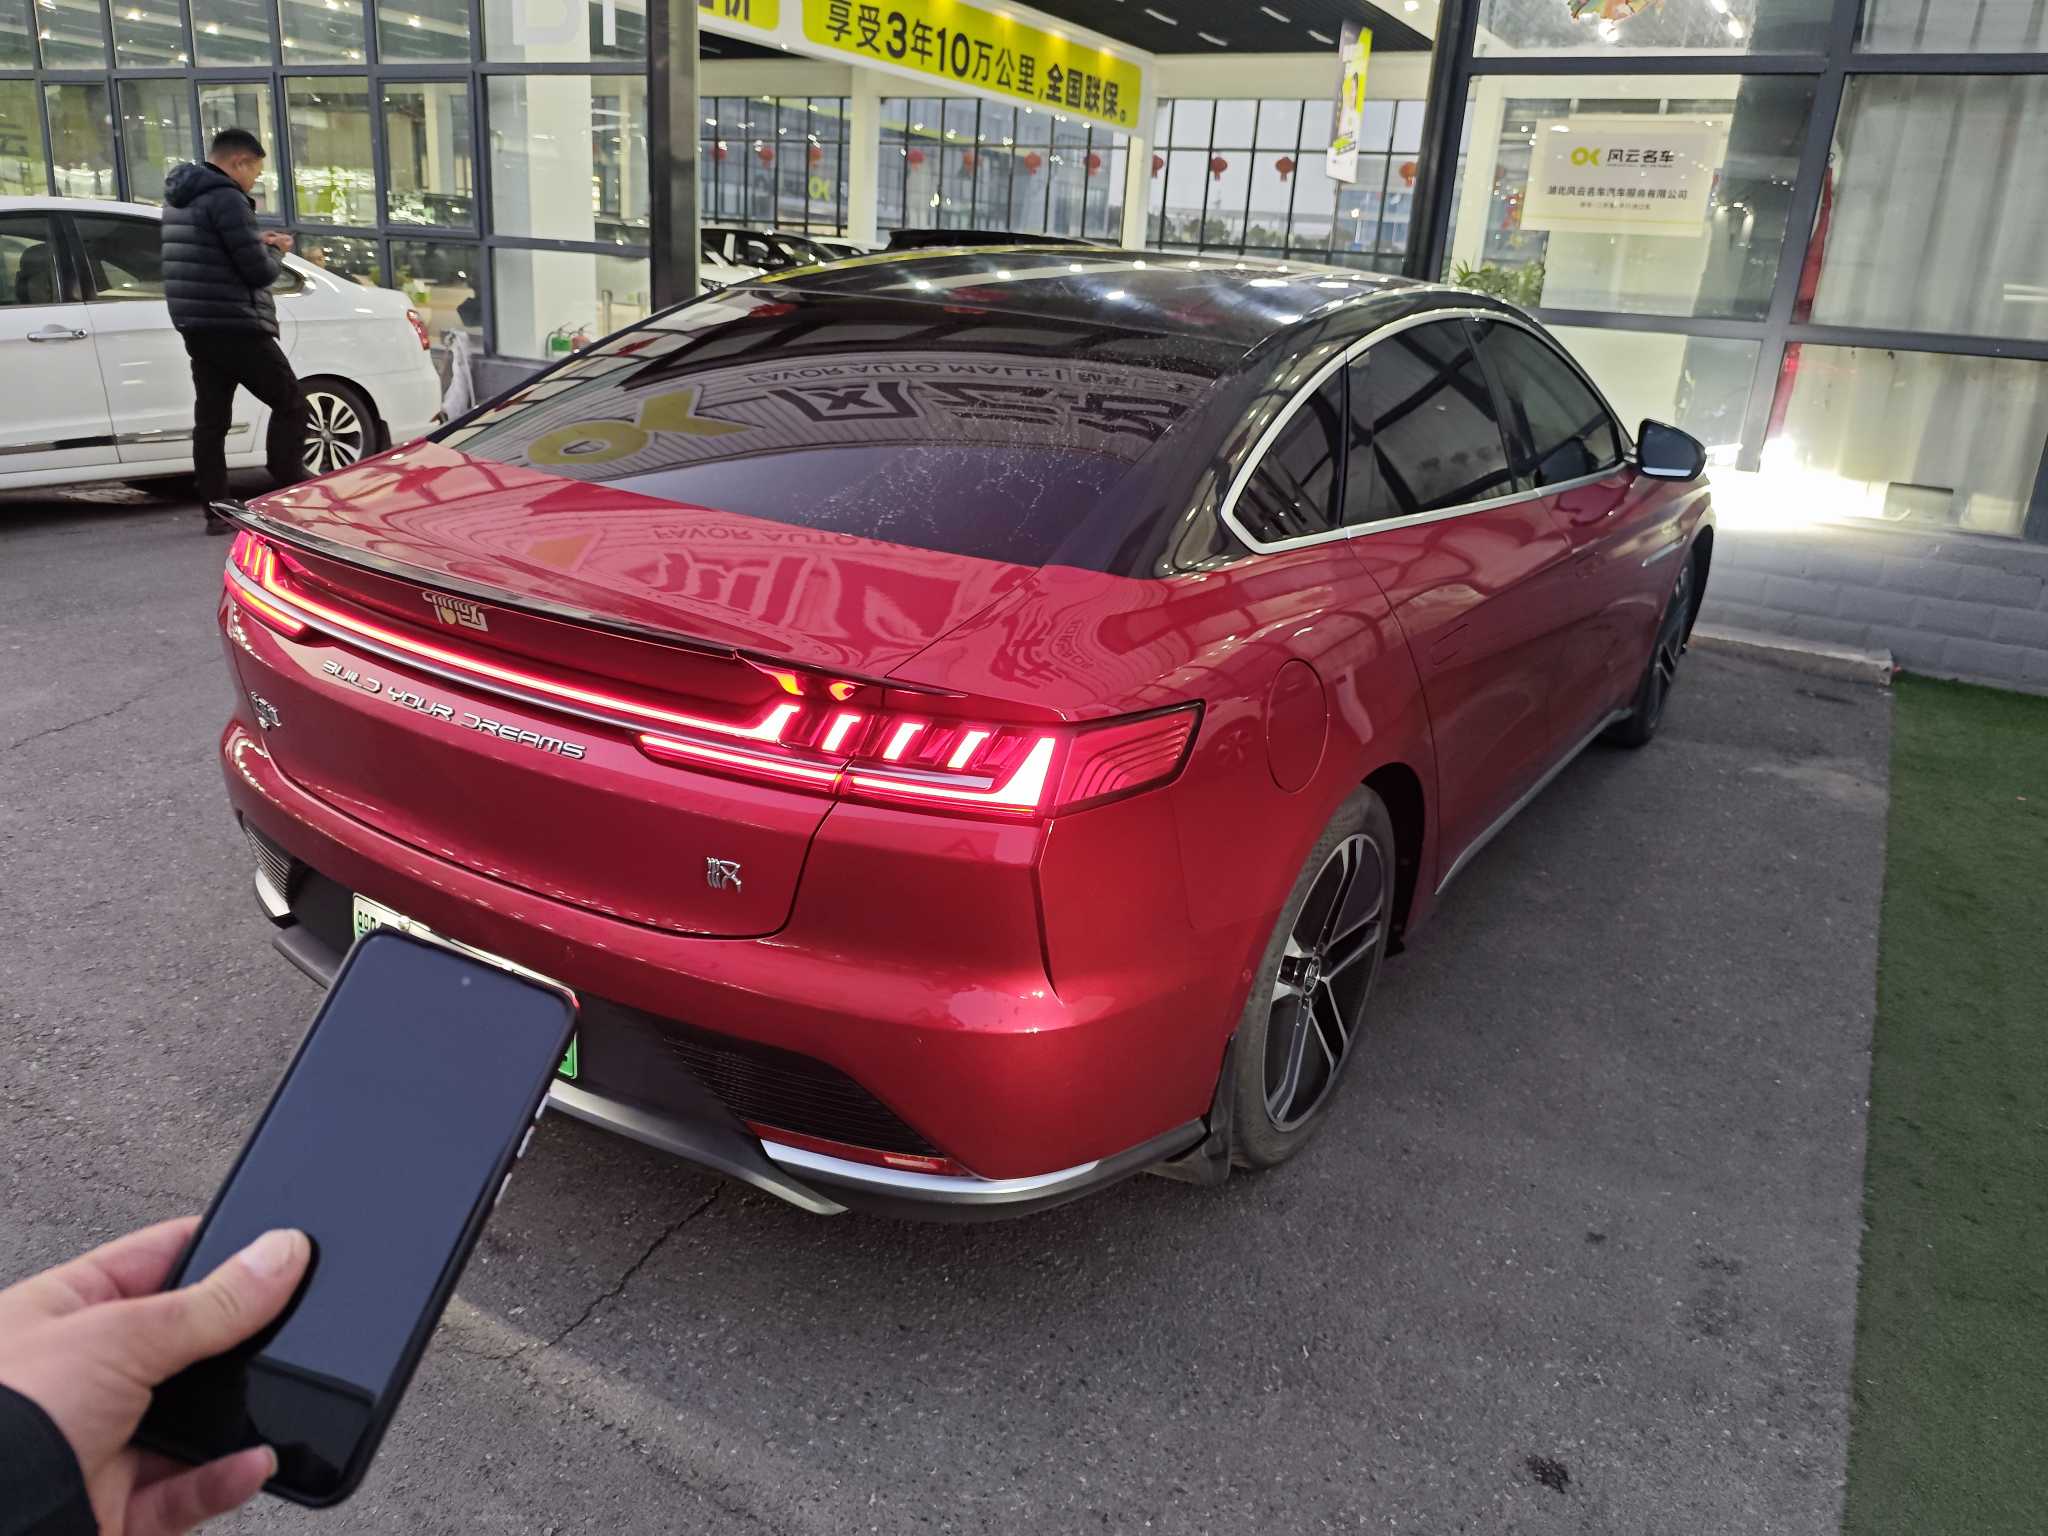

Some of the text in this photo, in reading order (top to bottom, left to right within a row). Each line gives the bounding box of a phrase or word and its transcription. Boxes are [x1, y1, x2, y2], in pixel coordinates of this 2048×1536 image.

[1607, 149, 1675, 164] 风云名车
[322, 659, 588, 761] BUILD YOUR DREAMS
